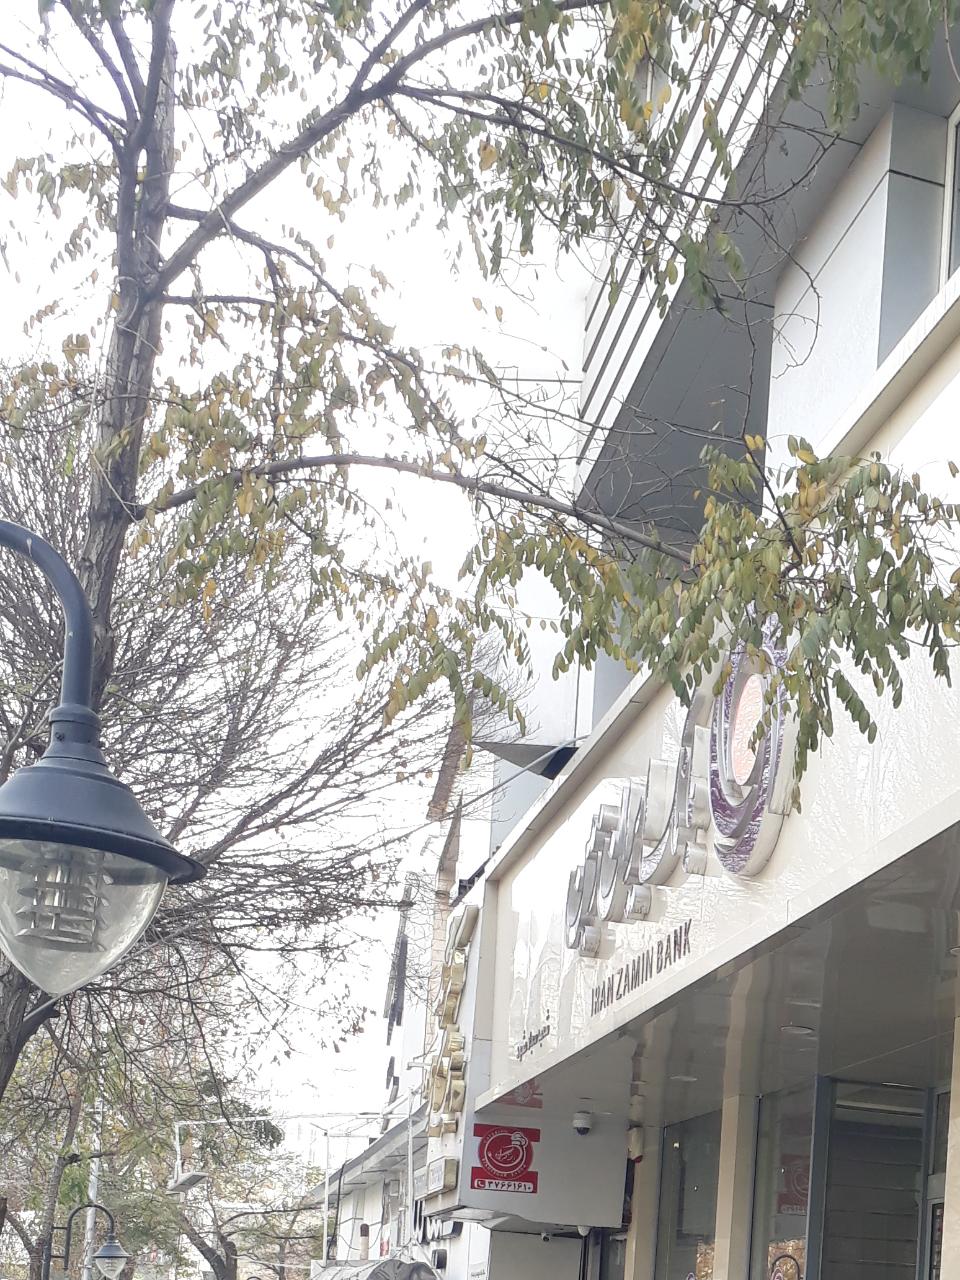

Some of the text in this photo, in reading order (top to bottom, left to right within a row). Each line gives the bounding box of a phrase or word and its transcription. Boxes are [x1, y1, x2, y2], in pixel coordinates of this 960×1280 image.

[590, 918, 693, 1018] IRAN ZAMIN BANK
